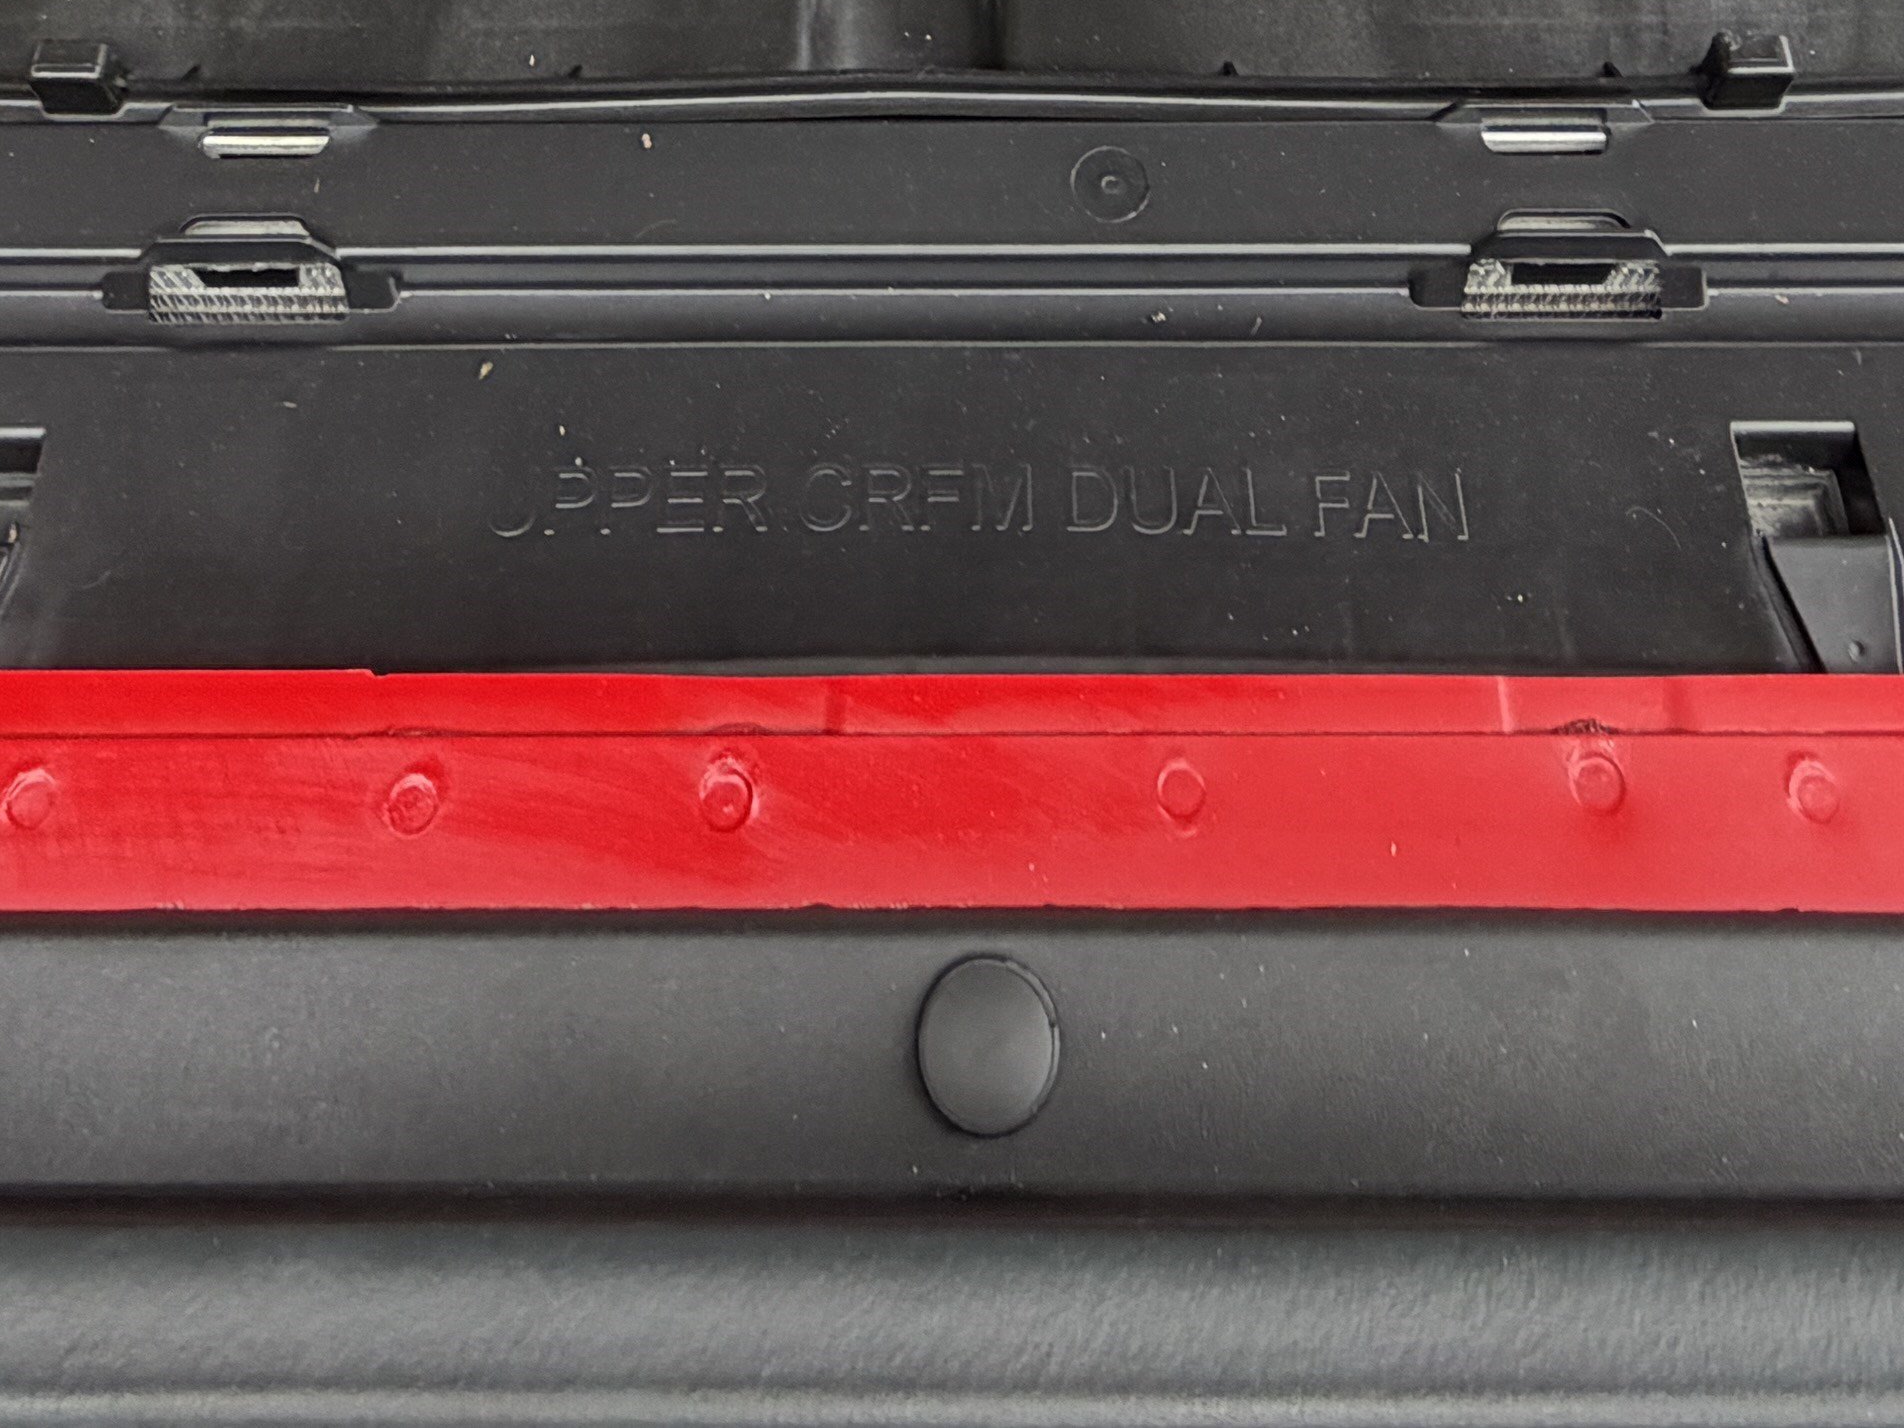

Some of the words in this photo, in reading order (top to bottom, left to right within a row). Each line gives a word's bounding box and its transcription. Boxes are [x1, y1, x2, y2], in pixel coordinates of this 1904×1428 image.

[489, 464, 768, 537] UPPER
[801, 463, 1034, 534] CRFM
[1066, 464, 1287, 535] DUAL
[1314, 467, 1470, 542] FAN
